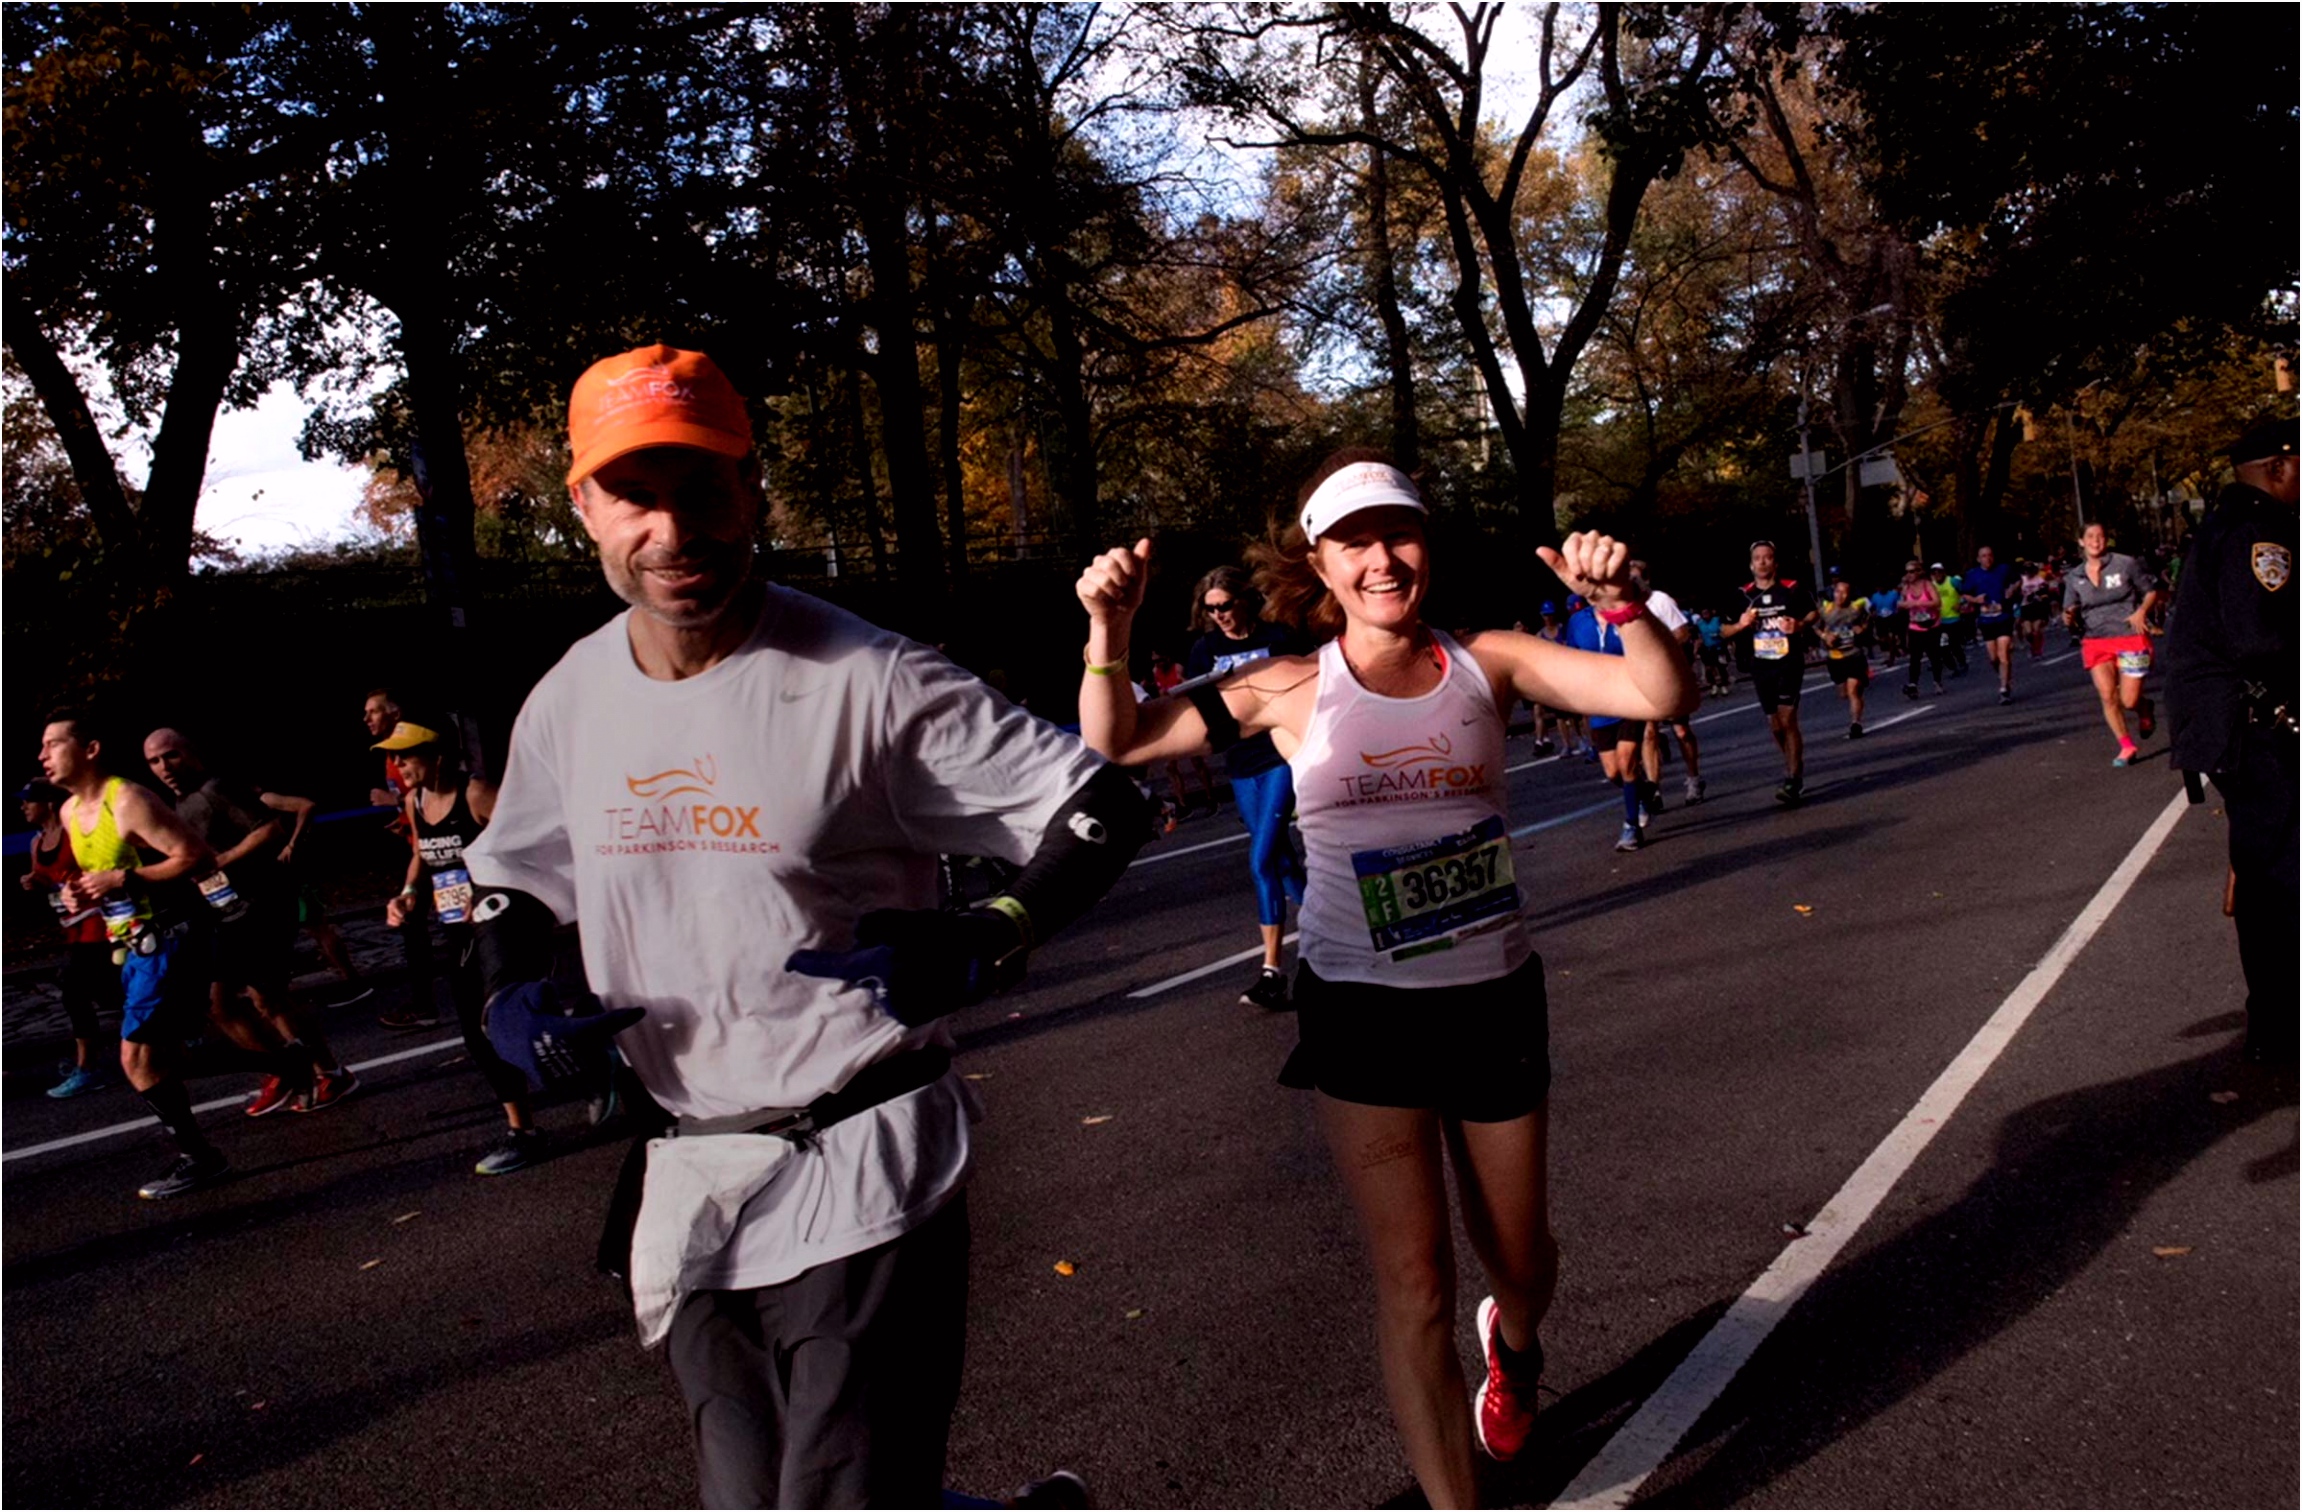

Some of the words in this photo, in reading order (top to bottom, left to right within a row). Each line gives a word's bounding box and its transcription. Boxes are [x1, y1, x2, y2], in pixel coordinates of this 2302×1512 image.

[2105, 574, 2122, 589] M
[1339, 763, 1485, 797] TEAMFOX
[1335, 799, 1356, 808] FOR
[604, 804, 761, 839] TEAMFOX
[1402, 845, 1499, 909] 36357
